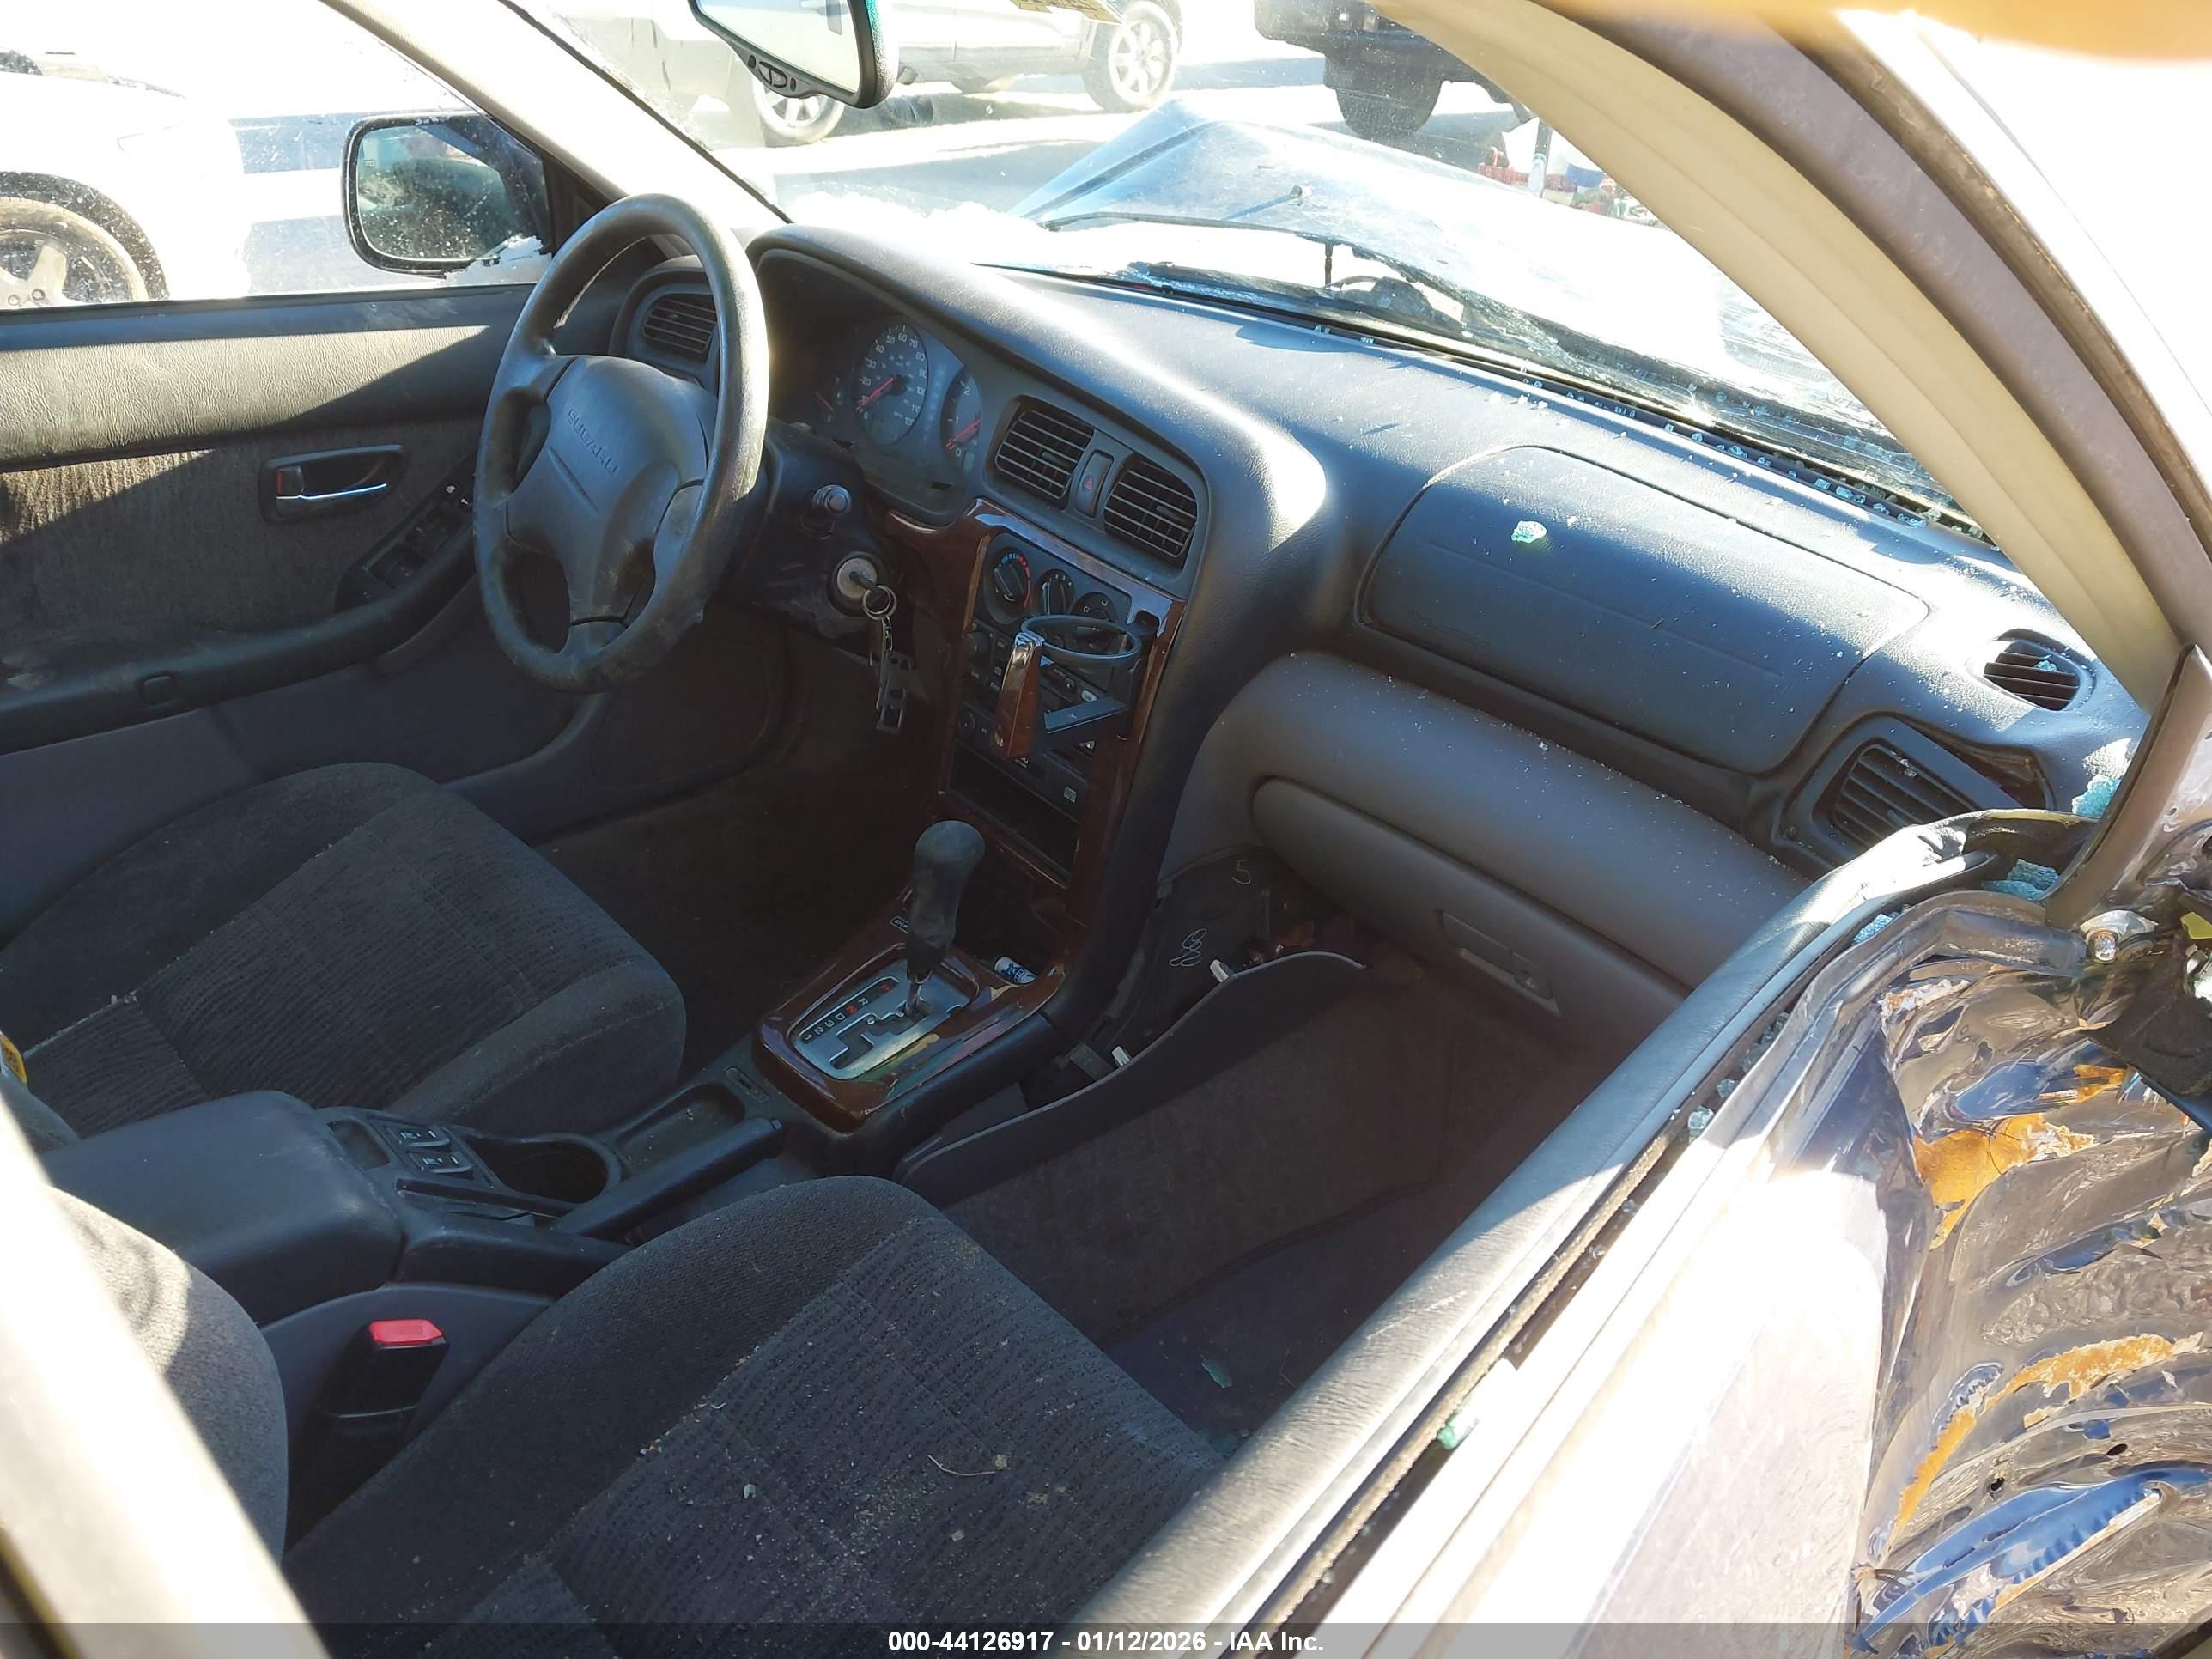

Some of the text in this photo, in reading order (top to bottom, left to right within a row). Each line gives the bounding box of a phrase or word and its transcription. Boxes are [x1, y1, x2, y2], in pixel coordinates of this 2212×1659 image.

[886, 335, 895, 344] 50
[898, 332, 908, 343] 60
[909, 338, 918, 348] 70
[875, 344, 884, 353] 40
[915, 351, 925, 362] 80
[963, 386, 971, 396] 2
[566, 408, 623, 477] SUBARU
[955, 447, 962, 457] 0
[859, 998, 868, 1006] R
